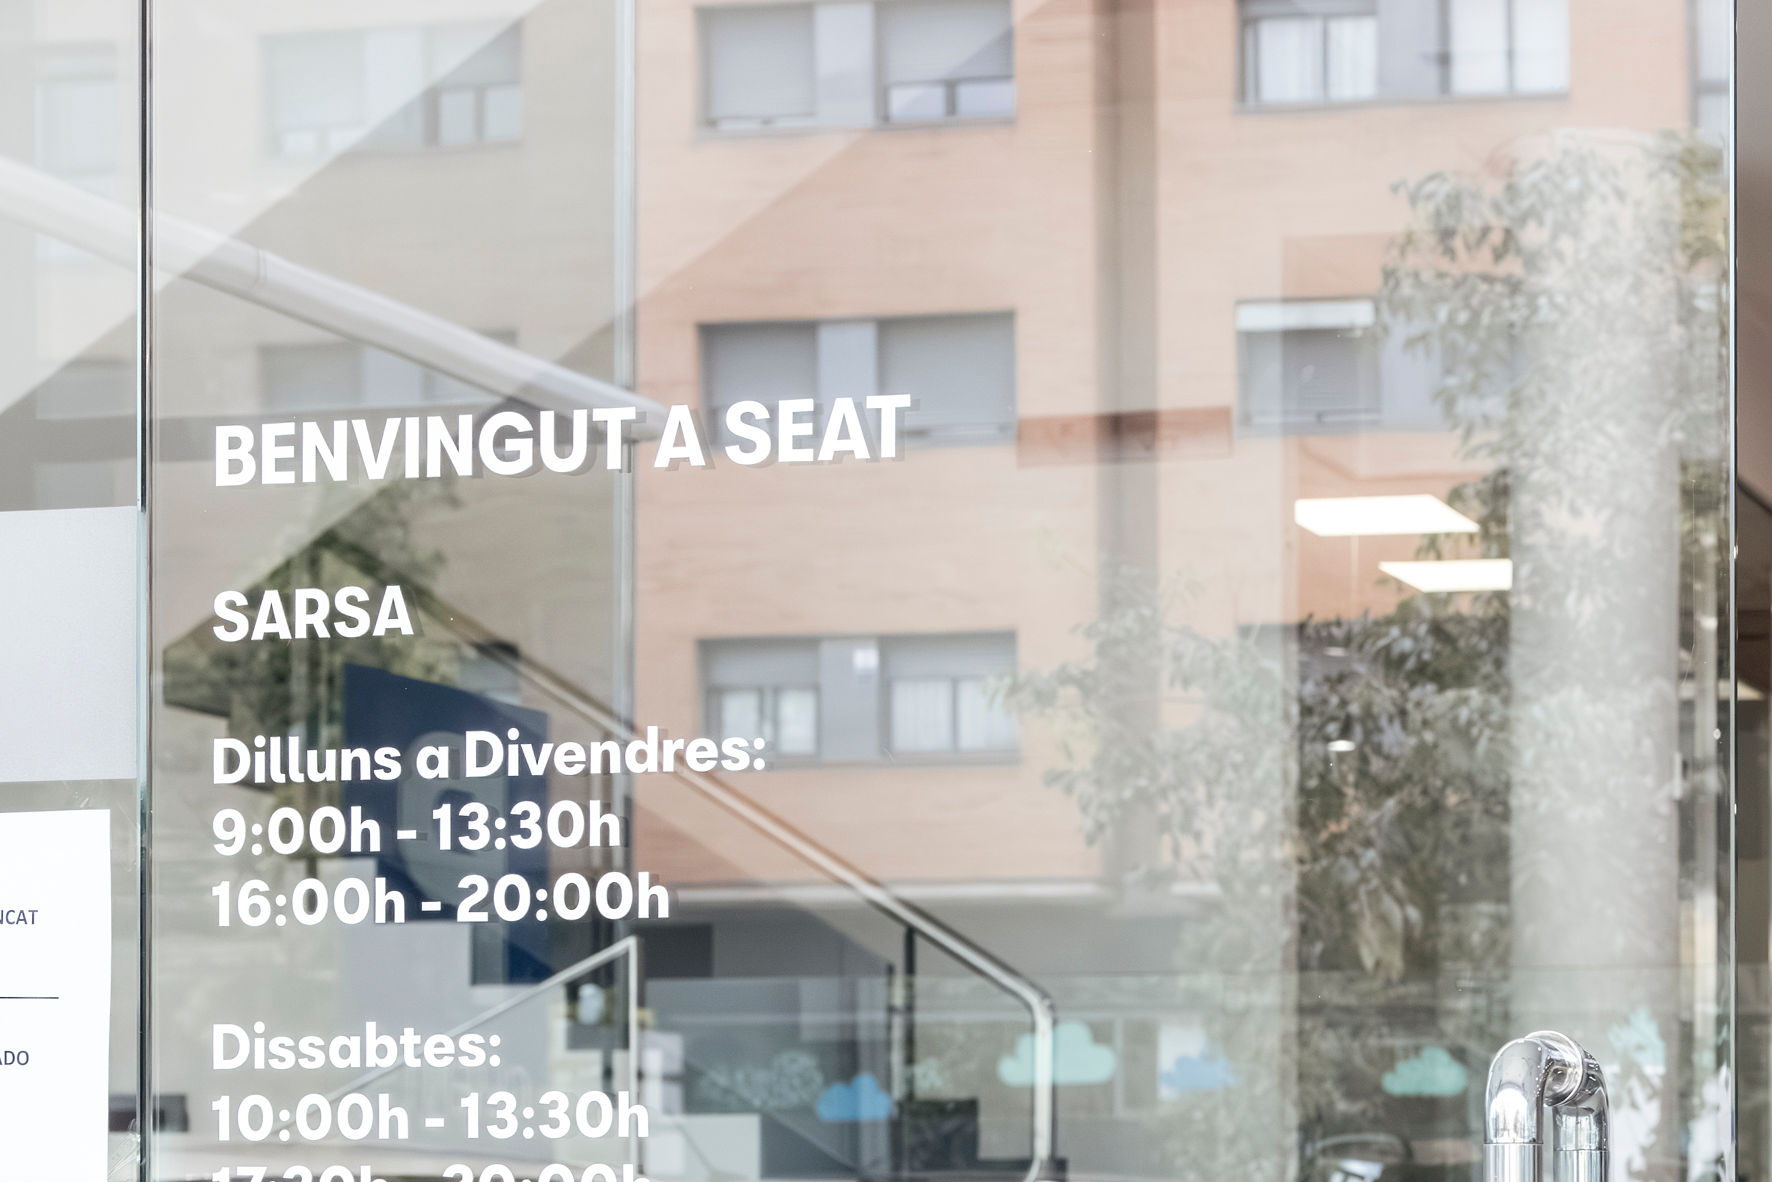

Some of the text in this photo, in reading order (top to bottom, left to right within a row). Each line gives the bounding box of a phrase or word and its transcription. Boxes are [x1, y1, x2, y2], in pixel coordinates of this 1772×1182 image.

[216, 395, 911, 487] BENVINGUT A SEAT
[213, 586, 414, 642] SARSA
[213, 726, 765, 784] Dilluns a Divendres:
[212, 801, 620, 856] 9:00h - 13:30h
[212, 872, 669, 927] 16:00h - 20:00h
[0, 1050, 30, 1066] DO
[213, 1022, 501, 1070] Dissabtes:
[212, 1090, 649, 1142] 10:00h - 13:30h
